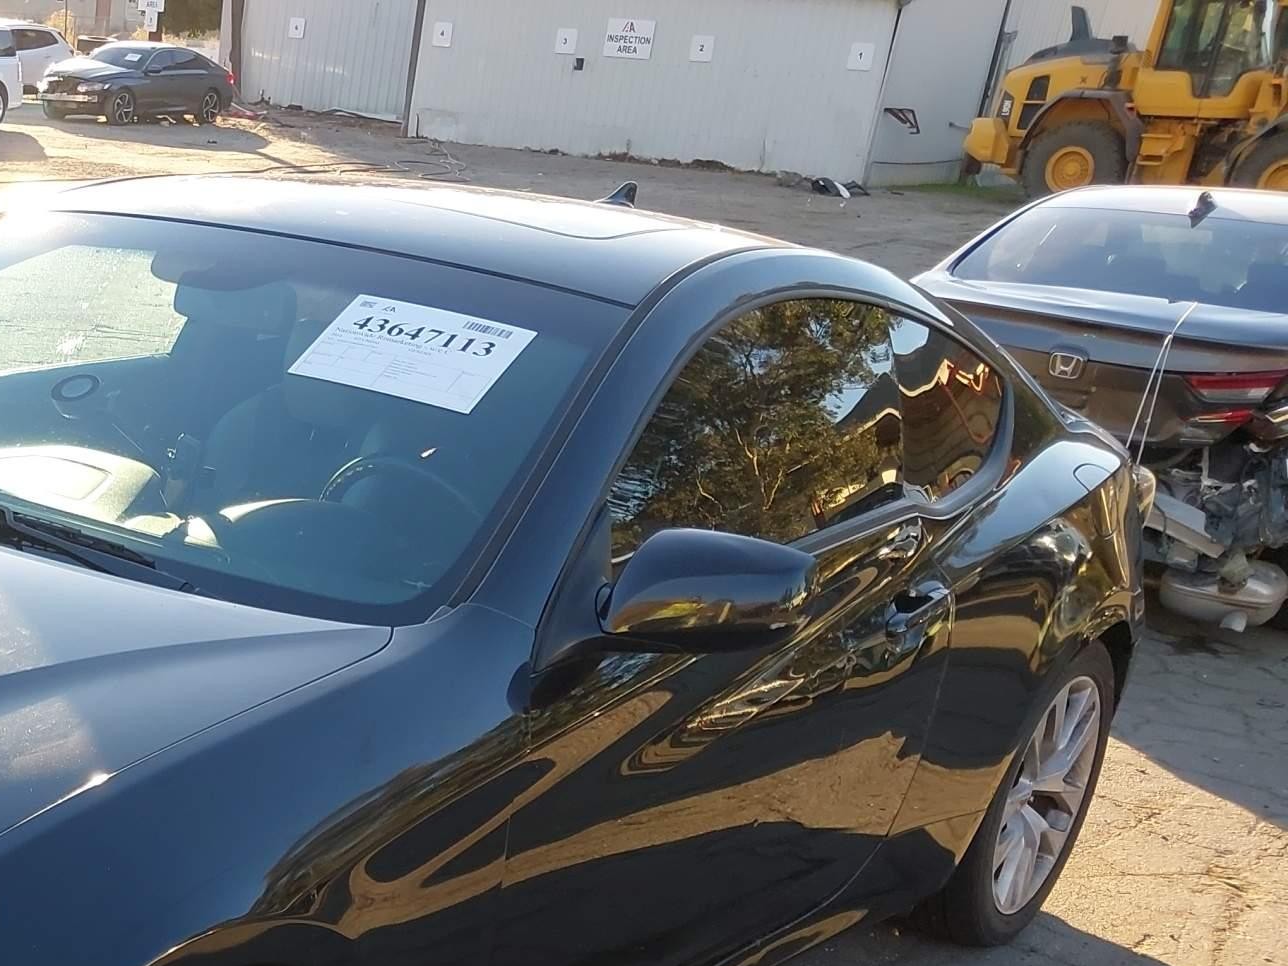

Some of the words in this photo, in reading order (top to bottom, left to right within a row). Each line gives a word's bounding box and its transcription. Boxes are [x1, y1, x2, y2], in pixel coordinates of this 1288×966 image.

[607, 34, 651, 45] INSPECTION
[617, 45, 637, 54] AREA
[859, 52, 863, 60] 1
[353, 315, 496, 357] 43647113
